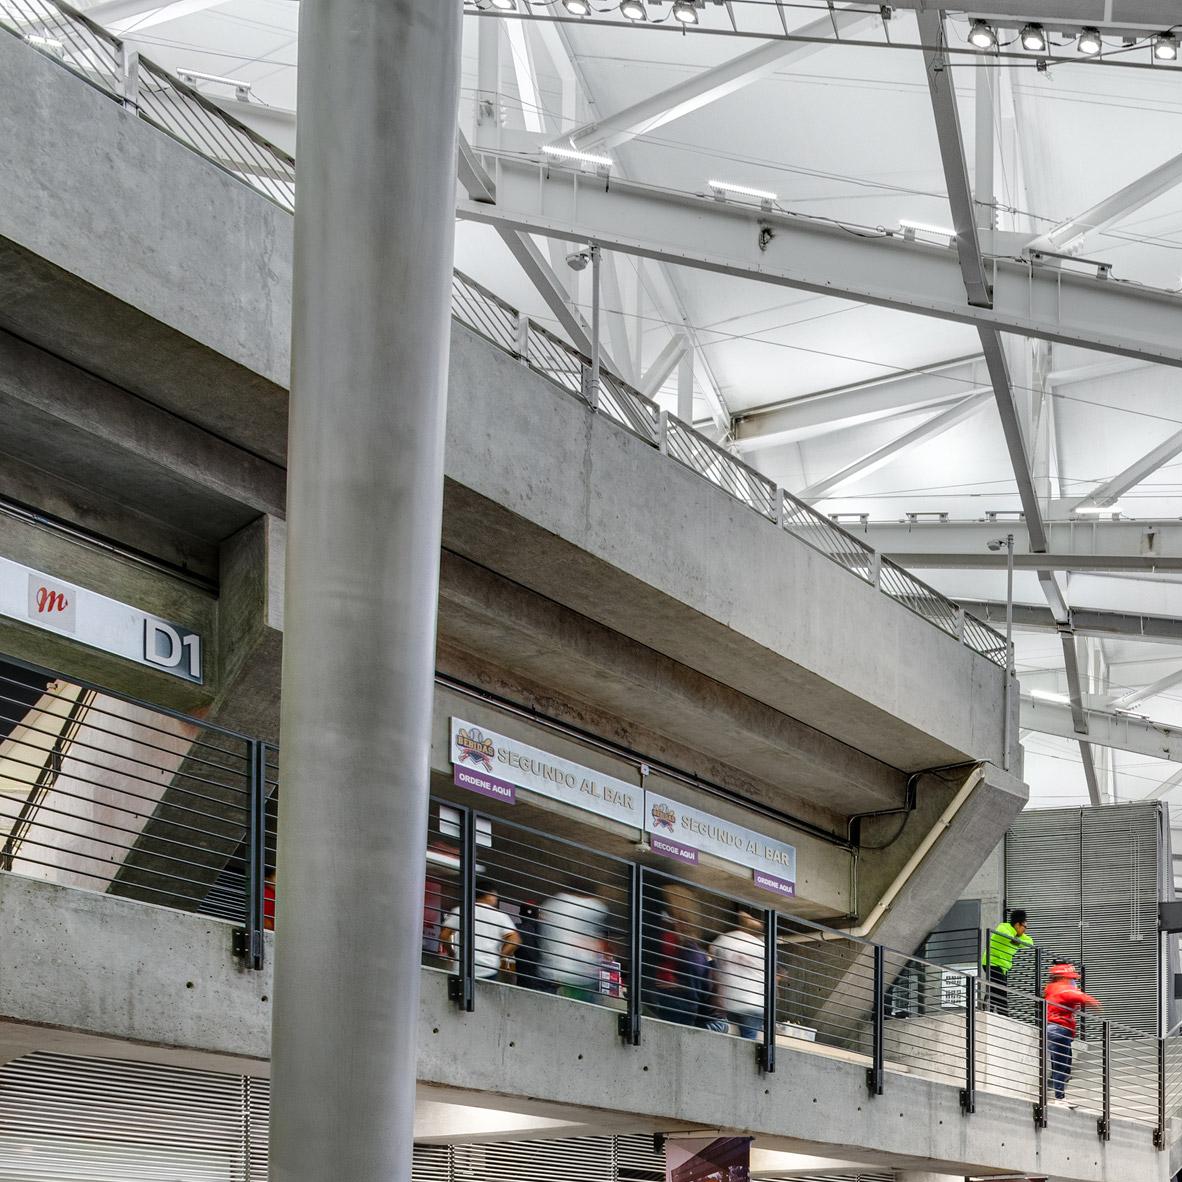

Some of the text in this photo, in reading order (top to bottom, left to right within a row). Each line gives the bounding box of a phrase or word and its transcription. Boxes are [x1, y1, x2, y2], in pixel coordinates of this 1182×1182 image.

[144, 619, 201, 678] D1
[457, 735, 495, 757] BEBIDAS
[459, 773, 512, 798] ORDENE AQUÍ
[497, 748, 635, 811] SEGUNDO AL BAR
[654, 841, 695, 860] RECOGE AQUÍ
[681, 816, 790, 867] SEGUNDO AL BAR
[757, 876, 793, 894] ORDENE AQUÍ
